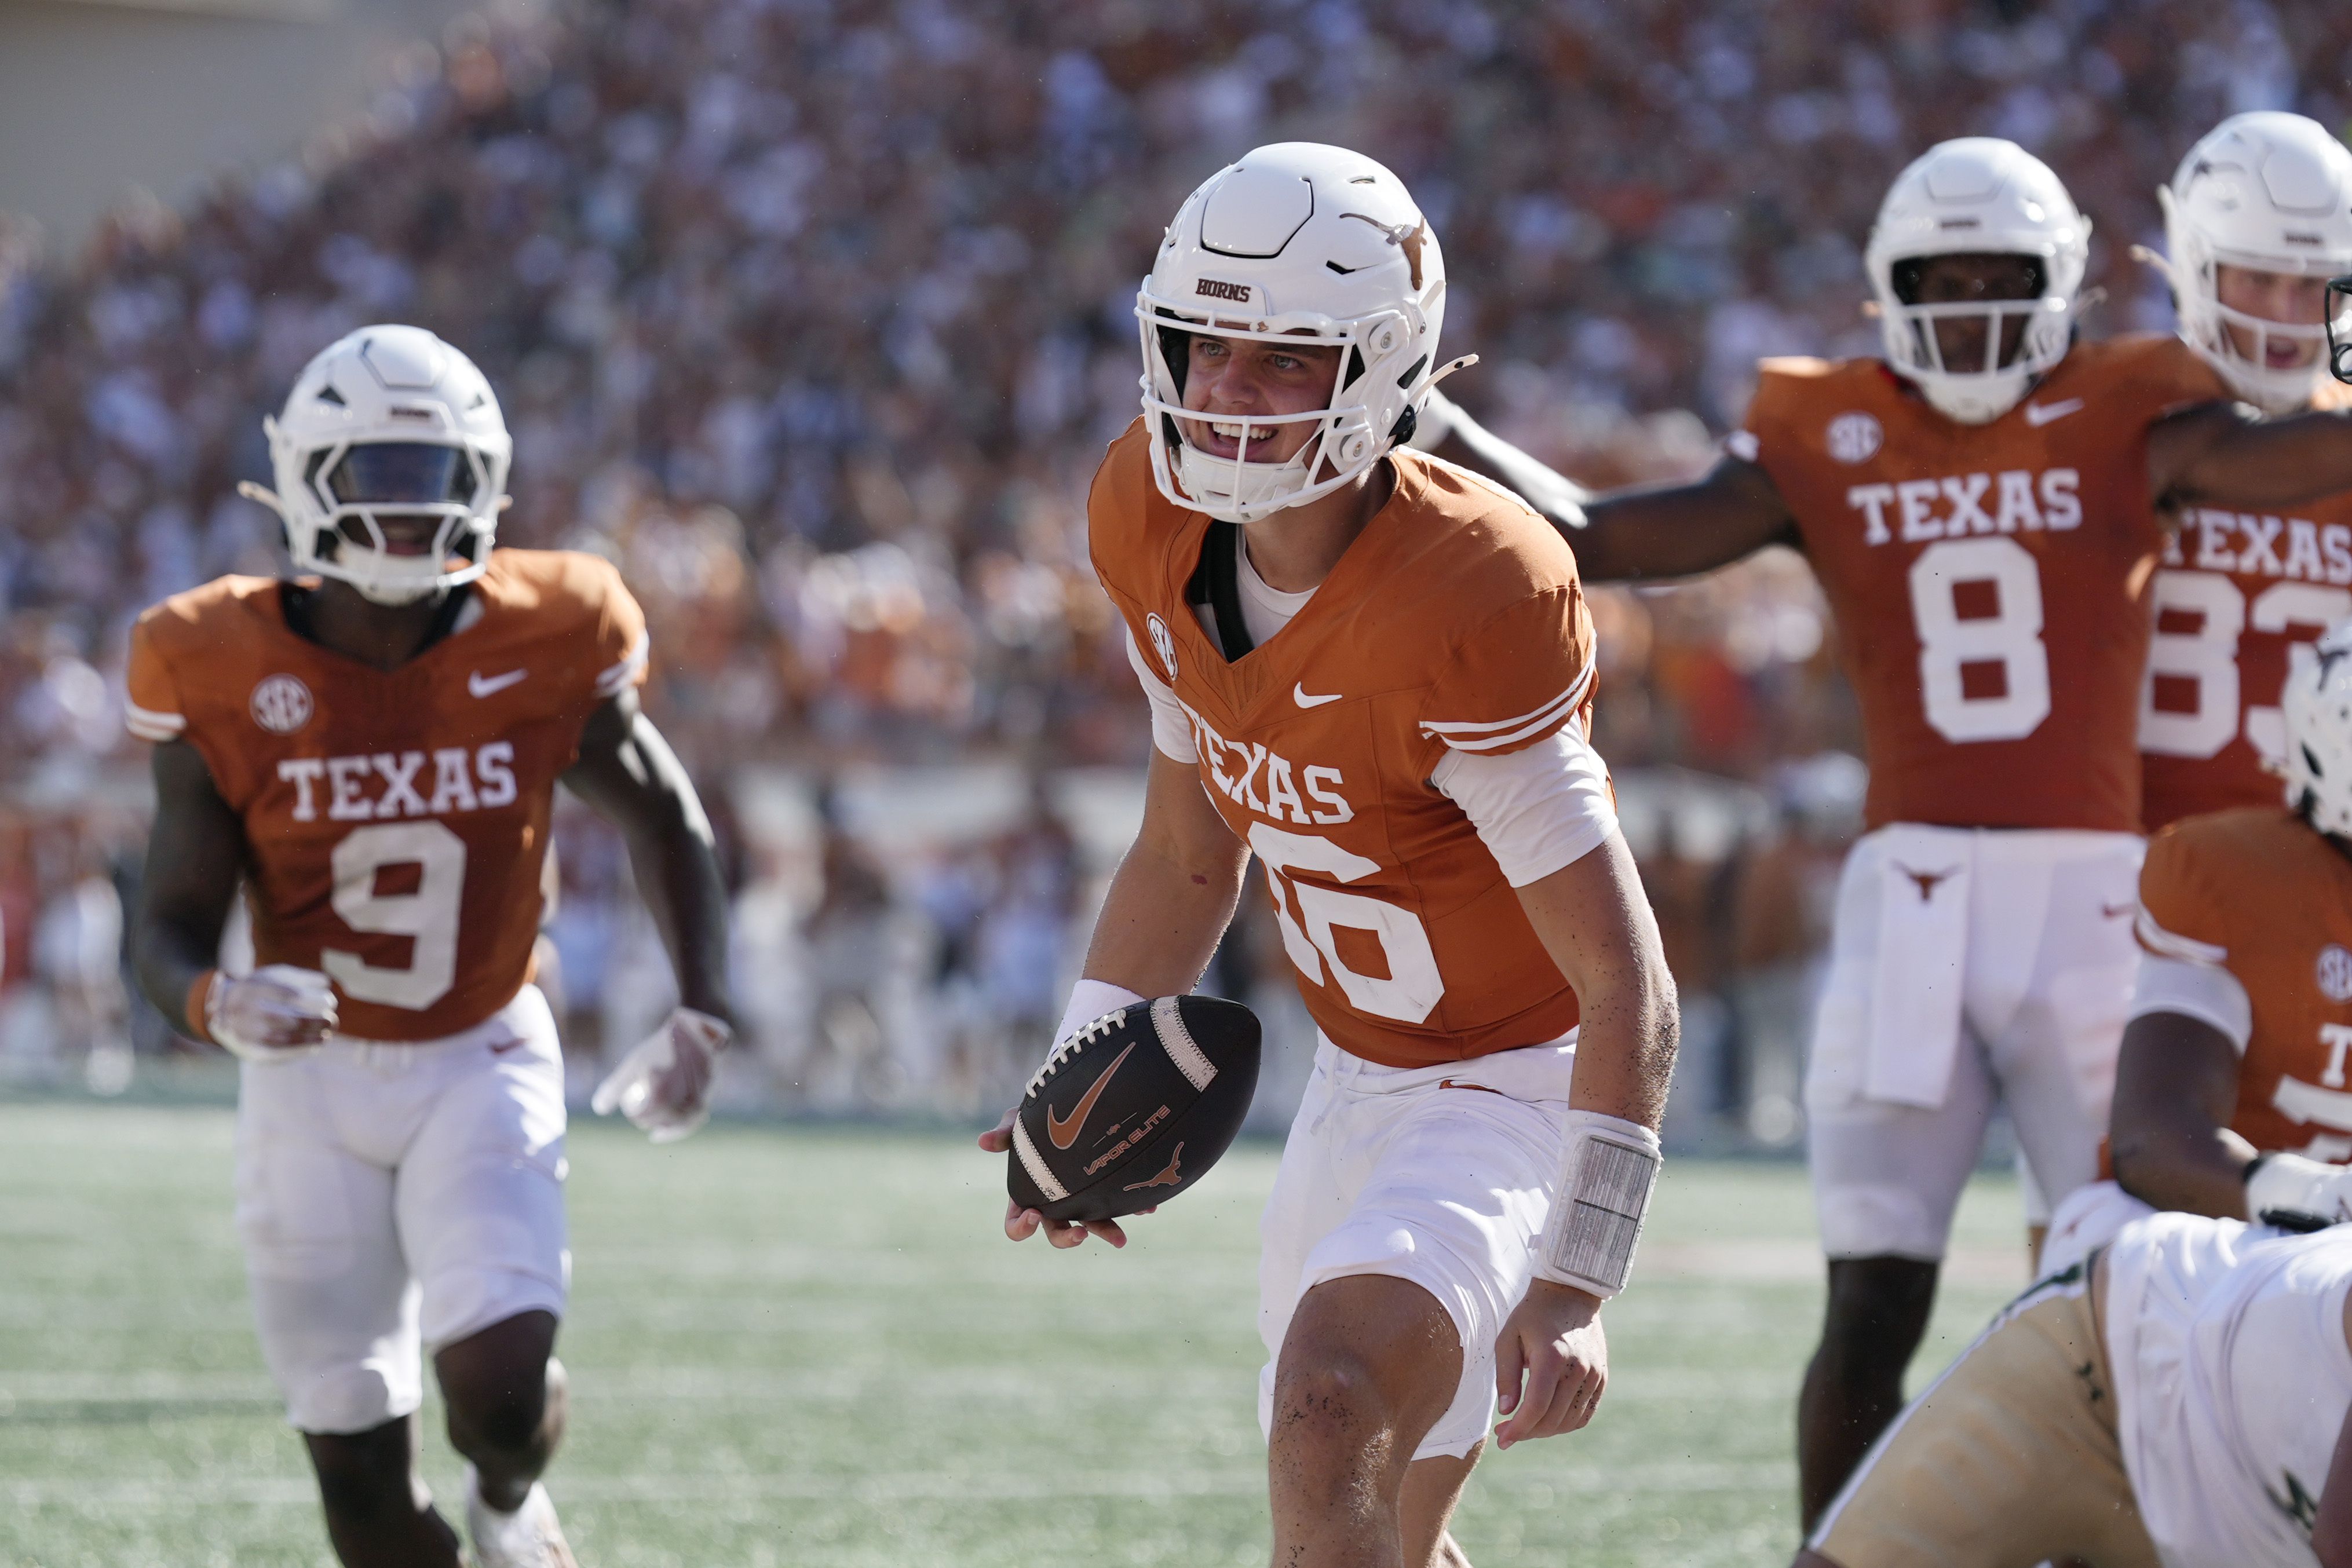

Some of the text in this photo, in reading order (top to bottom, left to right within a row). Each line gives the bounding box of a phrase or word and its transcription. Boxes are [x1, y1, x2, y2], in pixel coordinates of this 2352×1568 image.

[1196, 279, 1251, 302] HORNS
[1848, 468, 2082, 545] TEXAS
[1908, 535, 2051, 744] 8
[277, 740, 518, 823] TEXAS
[1174, 695, 1355, 825] TEXAS
[320, 818, 466, 1011] 9
[1083, 1105, 1171, 1175] VAPOR ELITE
